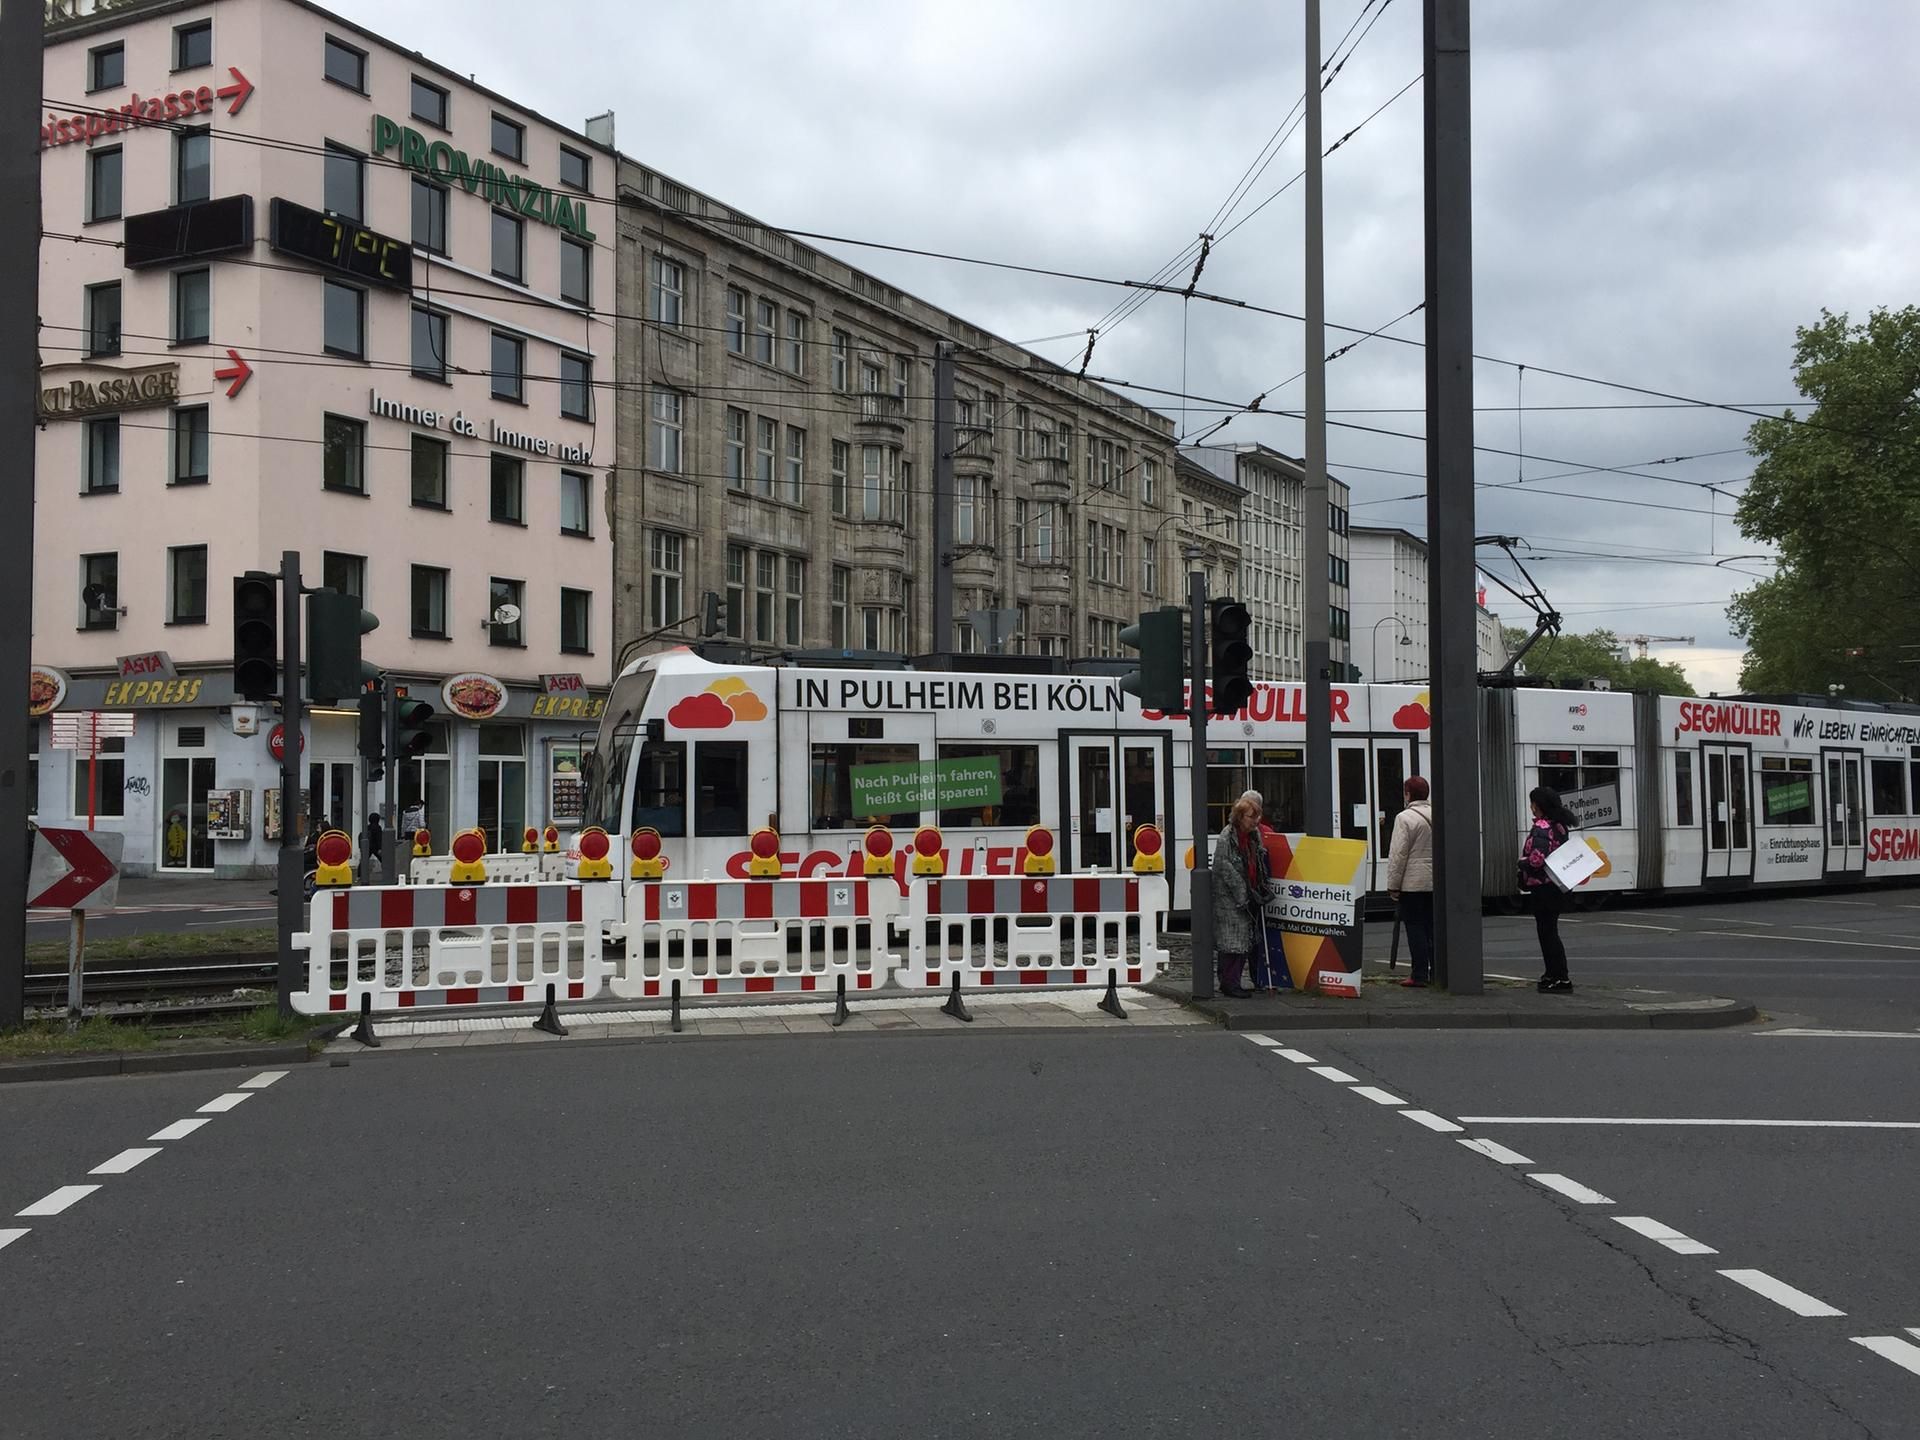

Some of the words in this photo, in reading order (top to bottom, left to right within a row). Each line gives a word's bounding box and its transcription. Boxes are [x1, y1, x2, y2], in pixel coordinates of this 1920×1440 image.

[372, 113, 596, 242] PROVINZIAL
[69, 372, 178, 409] PASSAGE
[370, 388, 443, 428] Immer
[452, 410, 479, 439] da.
[490, 418, 555, 455] Immer
[122, 654, 163, 676] ASIA
[104, 679, 202, 705] EXPRESS
[550, 674, 584, 692] ASIA
[796, 678, 829, 708] IN
[840, 679, 984, 710] PULHEIM
[993, 682, 1037, 711] BEI
[1047, 678, 1125, 712] KÖLN
[532, 695, 604, 718] EXPRES
[1679, 701, 1781, 736] SEGMÜLLER
[1819, 720, 1856, 740] LEBEN
[855, 775, 888, 789] Nach
[892, 771, 947, 786] Pulheim
[950, 768, 997, 782] fahren,
[865, 791, 902, 805] heißt
[905, 788, 936, 802] Geld
[939, 785, 988, 801] sparen!
[1769, 837, 1821, 851] Einrichtungshaus
[1867, 828, 1920, 862] SEGM
[1775, 852, 1808, 864] Extraklasse
[1288, 884, 1351, 902] Sherheit
[1267, 903, 1287, 916] und
[1290, 905, 1350, 926] Ordnung.
[1300, 925, 1318, 934] CDU
[1320, 975, 1343, 984] CDU
